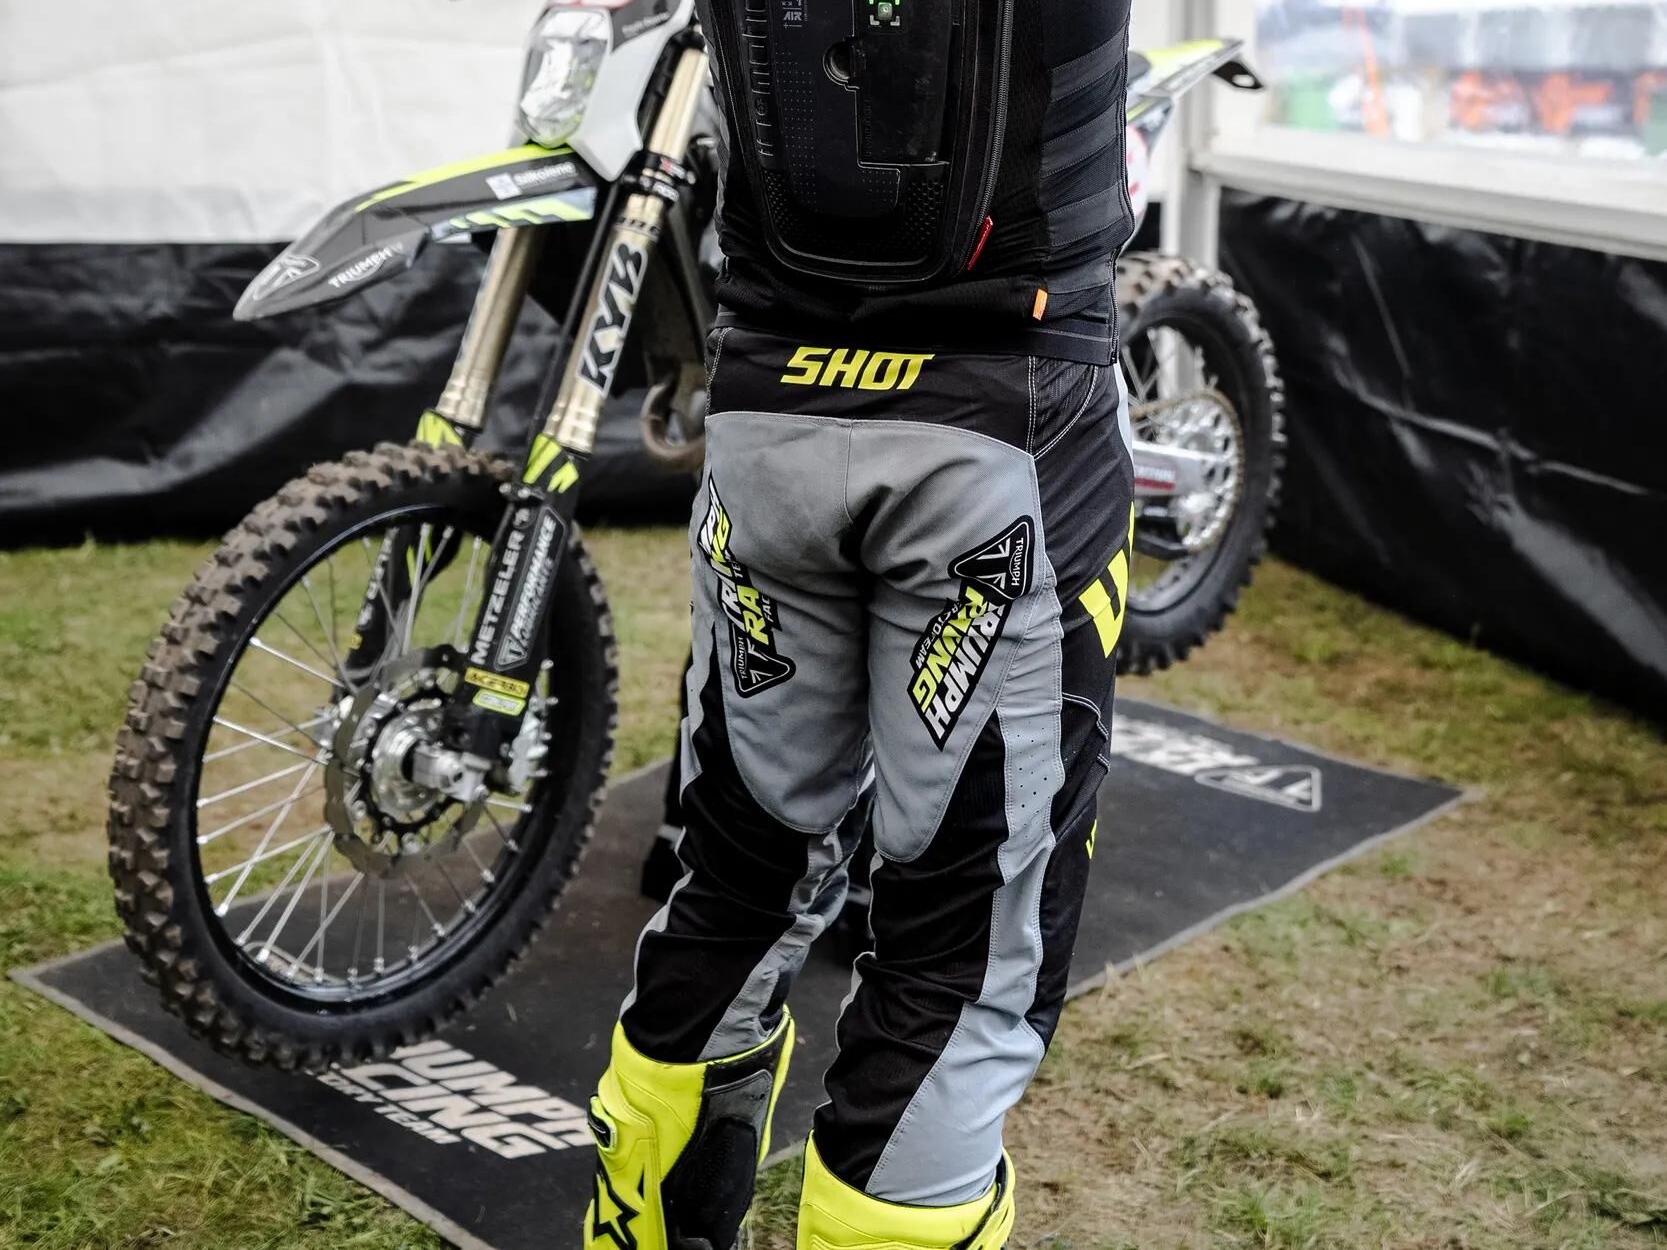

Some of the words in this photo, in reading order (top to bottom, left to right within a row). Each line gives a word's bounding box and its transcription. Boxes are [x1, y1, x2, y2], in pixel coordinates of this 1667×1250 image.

[328, 247, 393, 288] TRIUMPH
[578, 242, 648, 395] KYB
[780, 347, 935, 390] SHOT
[510, 515, 557, 638] PERFORMANCE
[1011, 537, 1024, 587] TRIUMPH
[470, 530, 525, 665] METZELER
[736, 636, 748, 680] TRIUMPH
[333, 1063, 571, 1159] CING
[373, 1101, 463, 1144] TEAM
